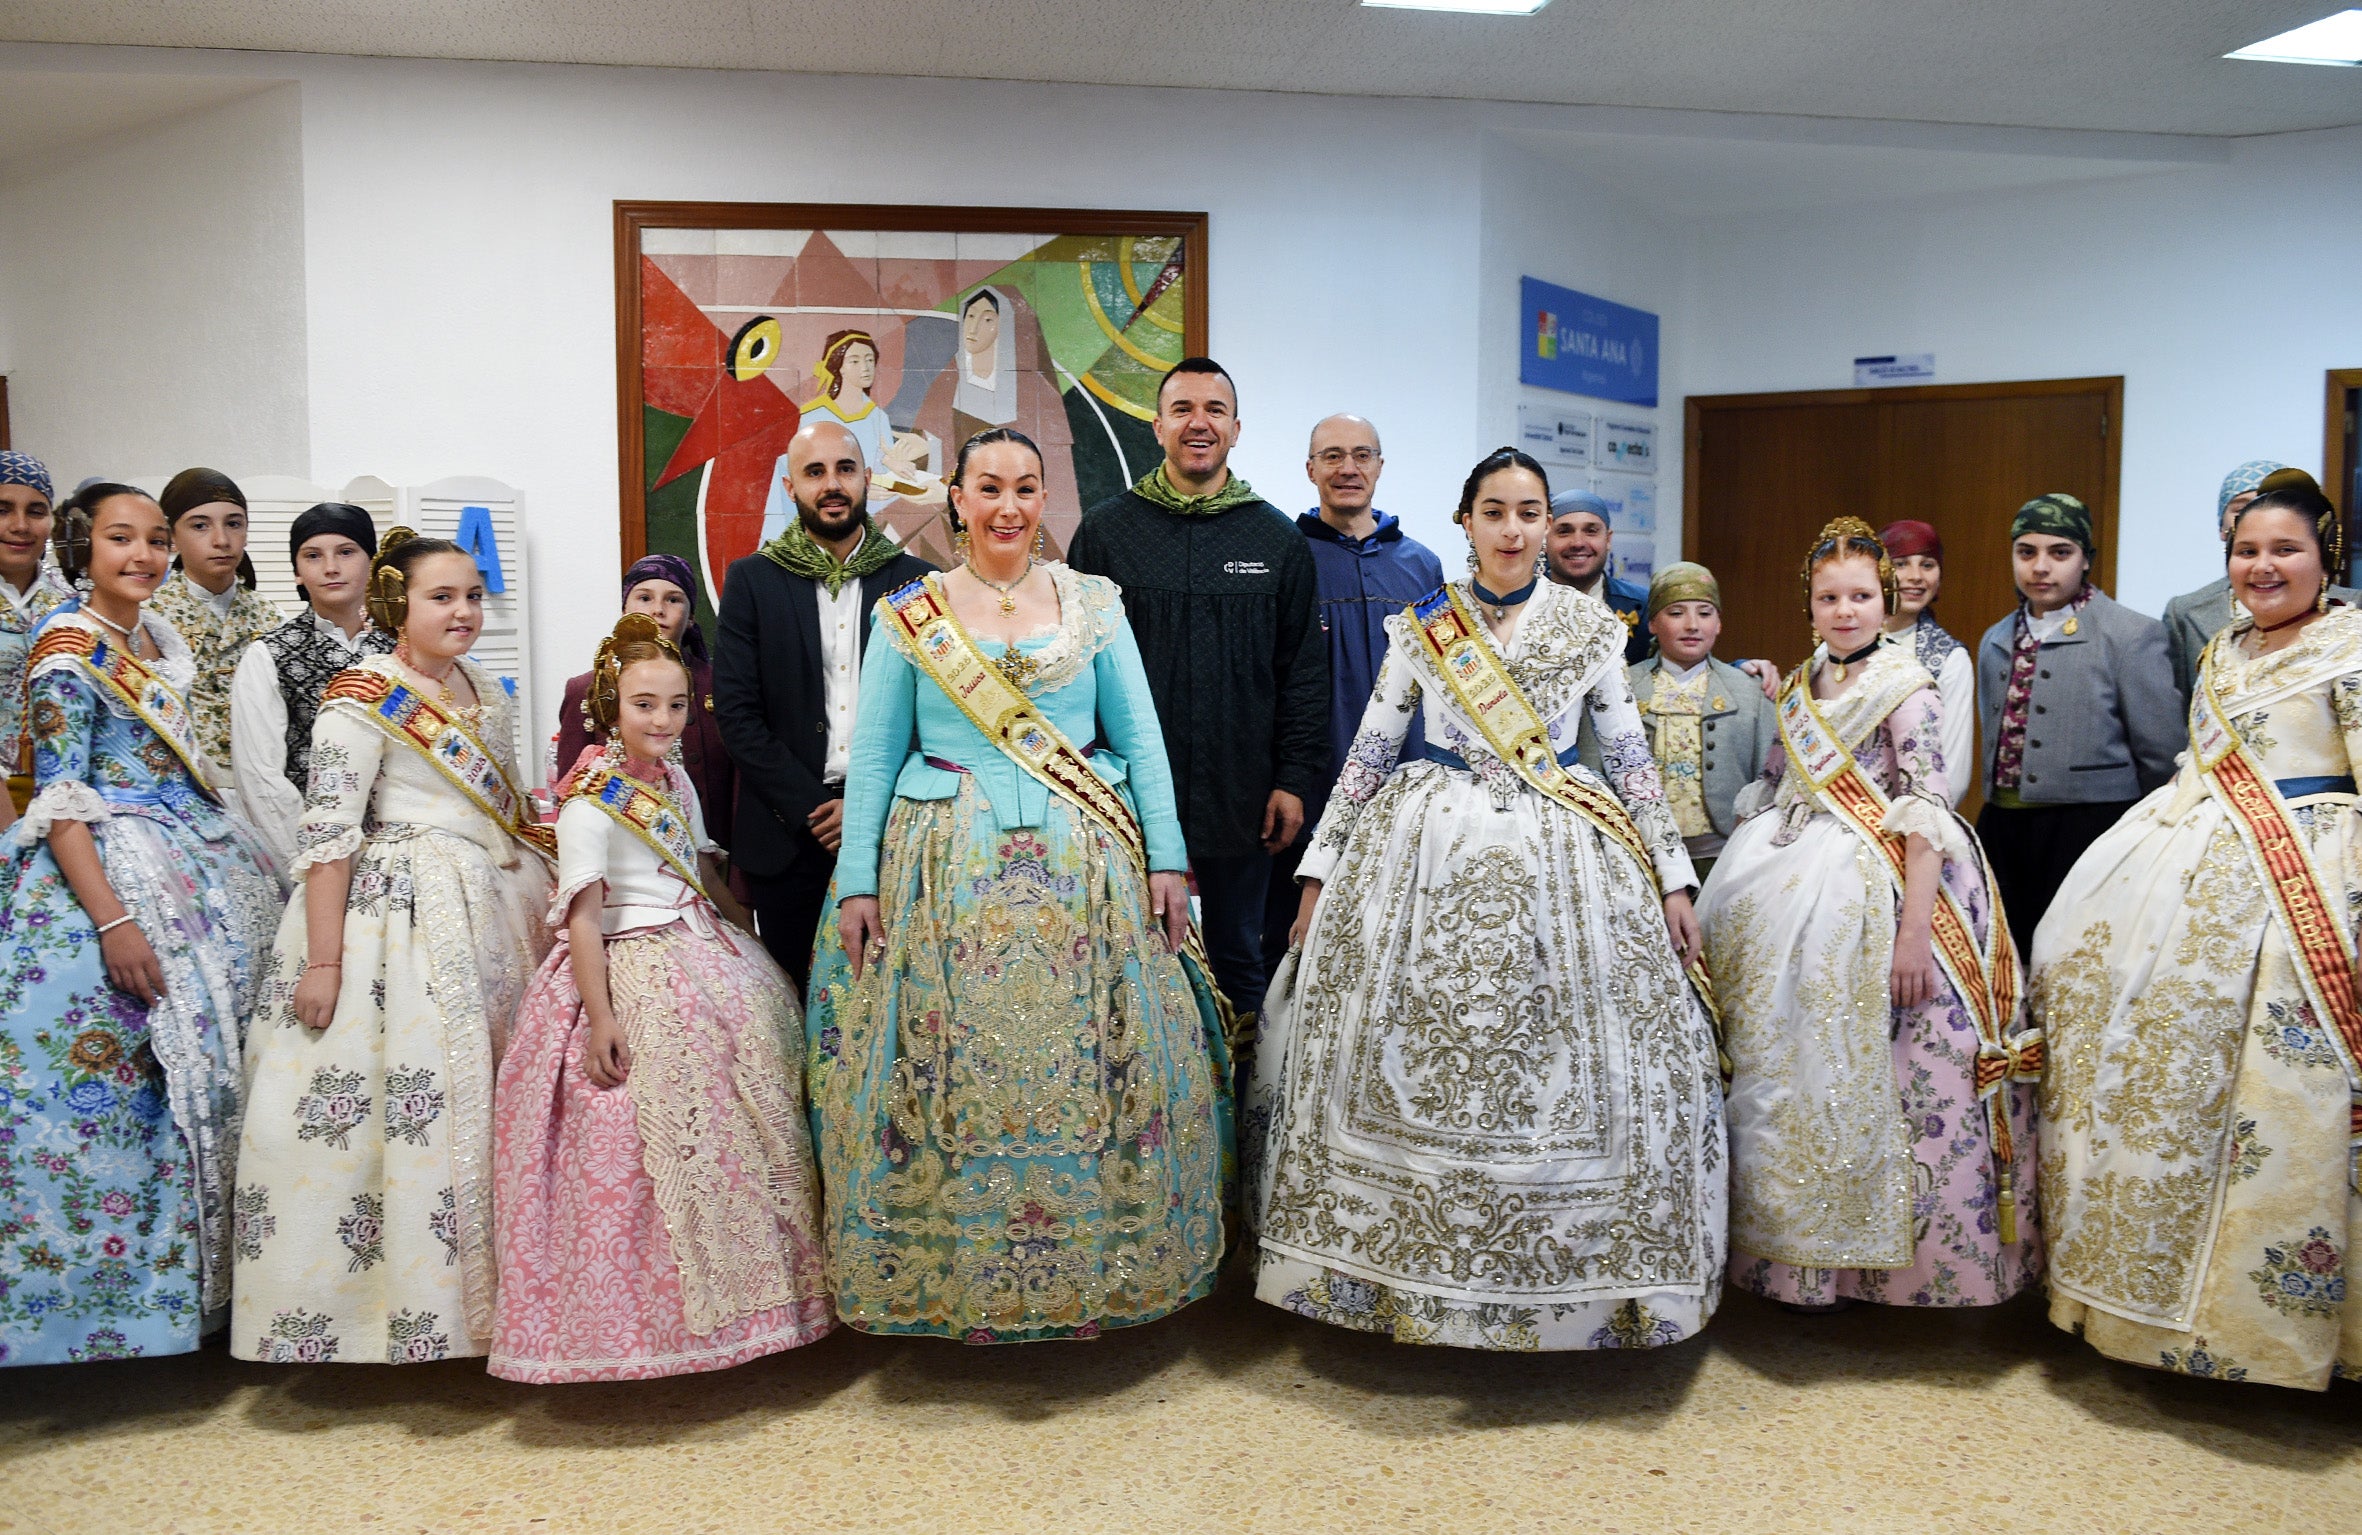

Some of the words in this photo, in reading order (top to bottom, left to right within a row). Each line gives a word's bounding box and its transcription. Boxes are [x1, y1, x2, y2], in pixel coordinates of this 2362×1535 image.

[1561, 327, 1598, 358] SANTA
[1601, 339, 1627, 365] ANA
[959, 672, 986, 699] Jessica
[1477, 690, 1508, 715] Daniela
